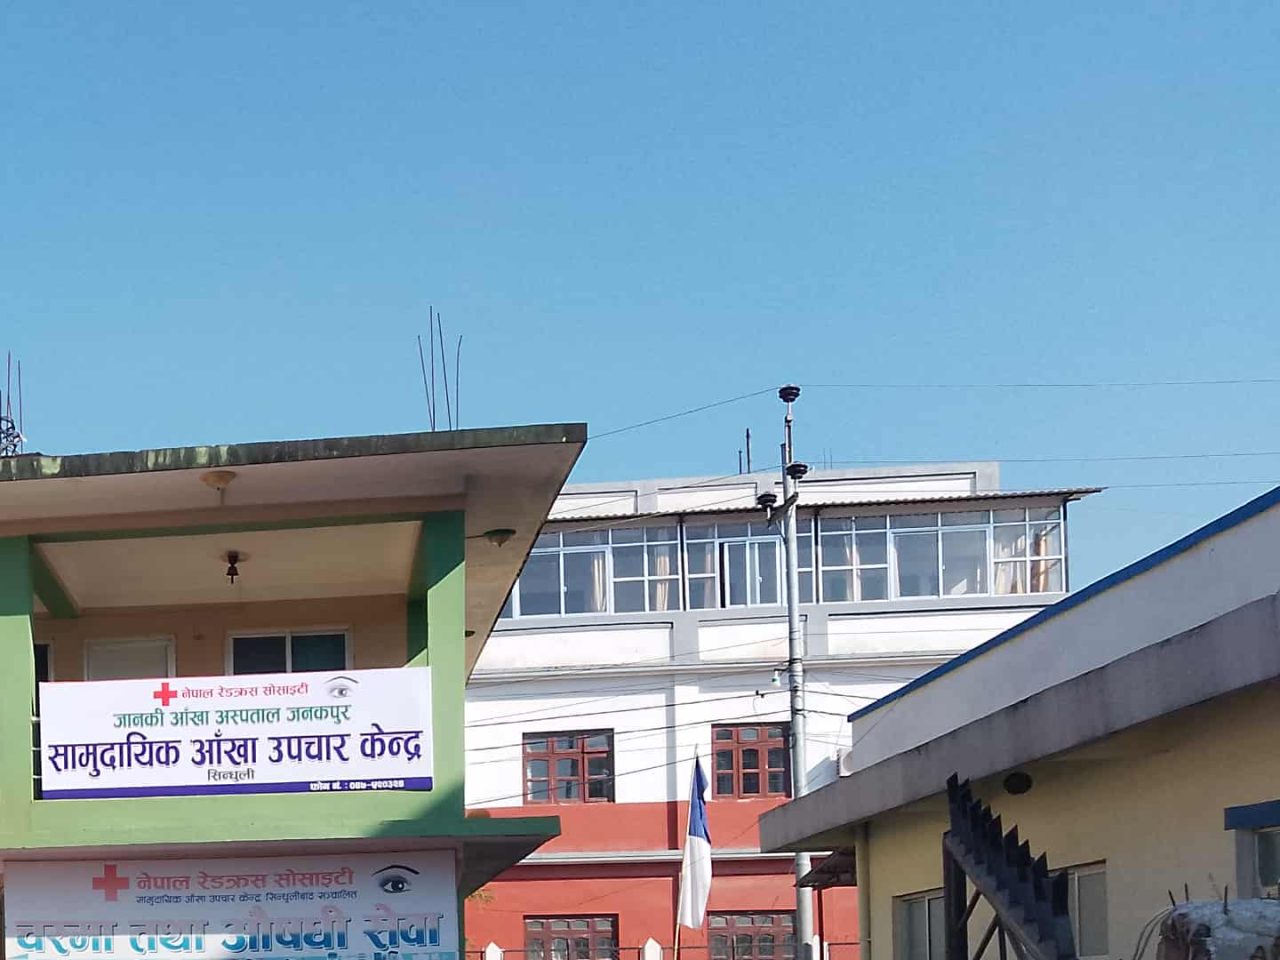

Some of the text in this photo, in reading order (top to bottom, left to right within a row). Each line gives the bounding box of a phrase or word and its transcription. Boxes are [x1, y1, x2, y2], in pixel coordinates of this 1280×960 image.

[182, 682, 309, 699] नेपाल रेडक्रस सोसाइटी
[113, 708, 165, 729] जानकी
[215, 707, 281, 726] अस्पताल
[286, 704, 352, 725] जनकपुर
[48, 723, 424, 777] सामुदायिक आँखा उपचार केन्द्र
[207, 767, 255, 782] सिन्धुली
[136, 867, 355, 890] नेपाल रेडक्रस सोसाइटी
[209, 893, 235, 903] उपचार
